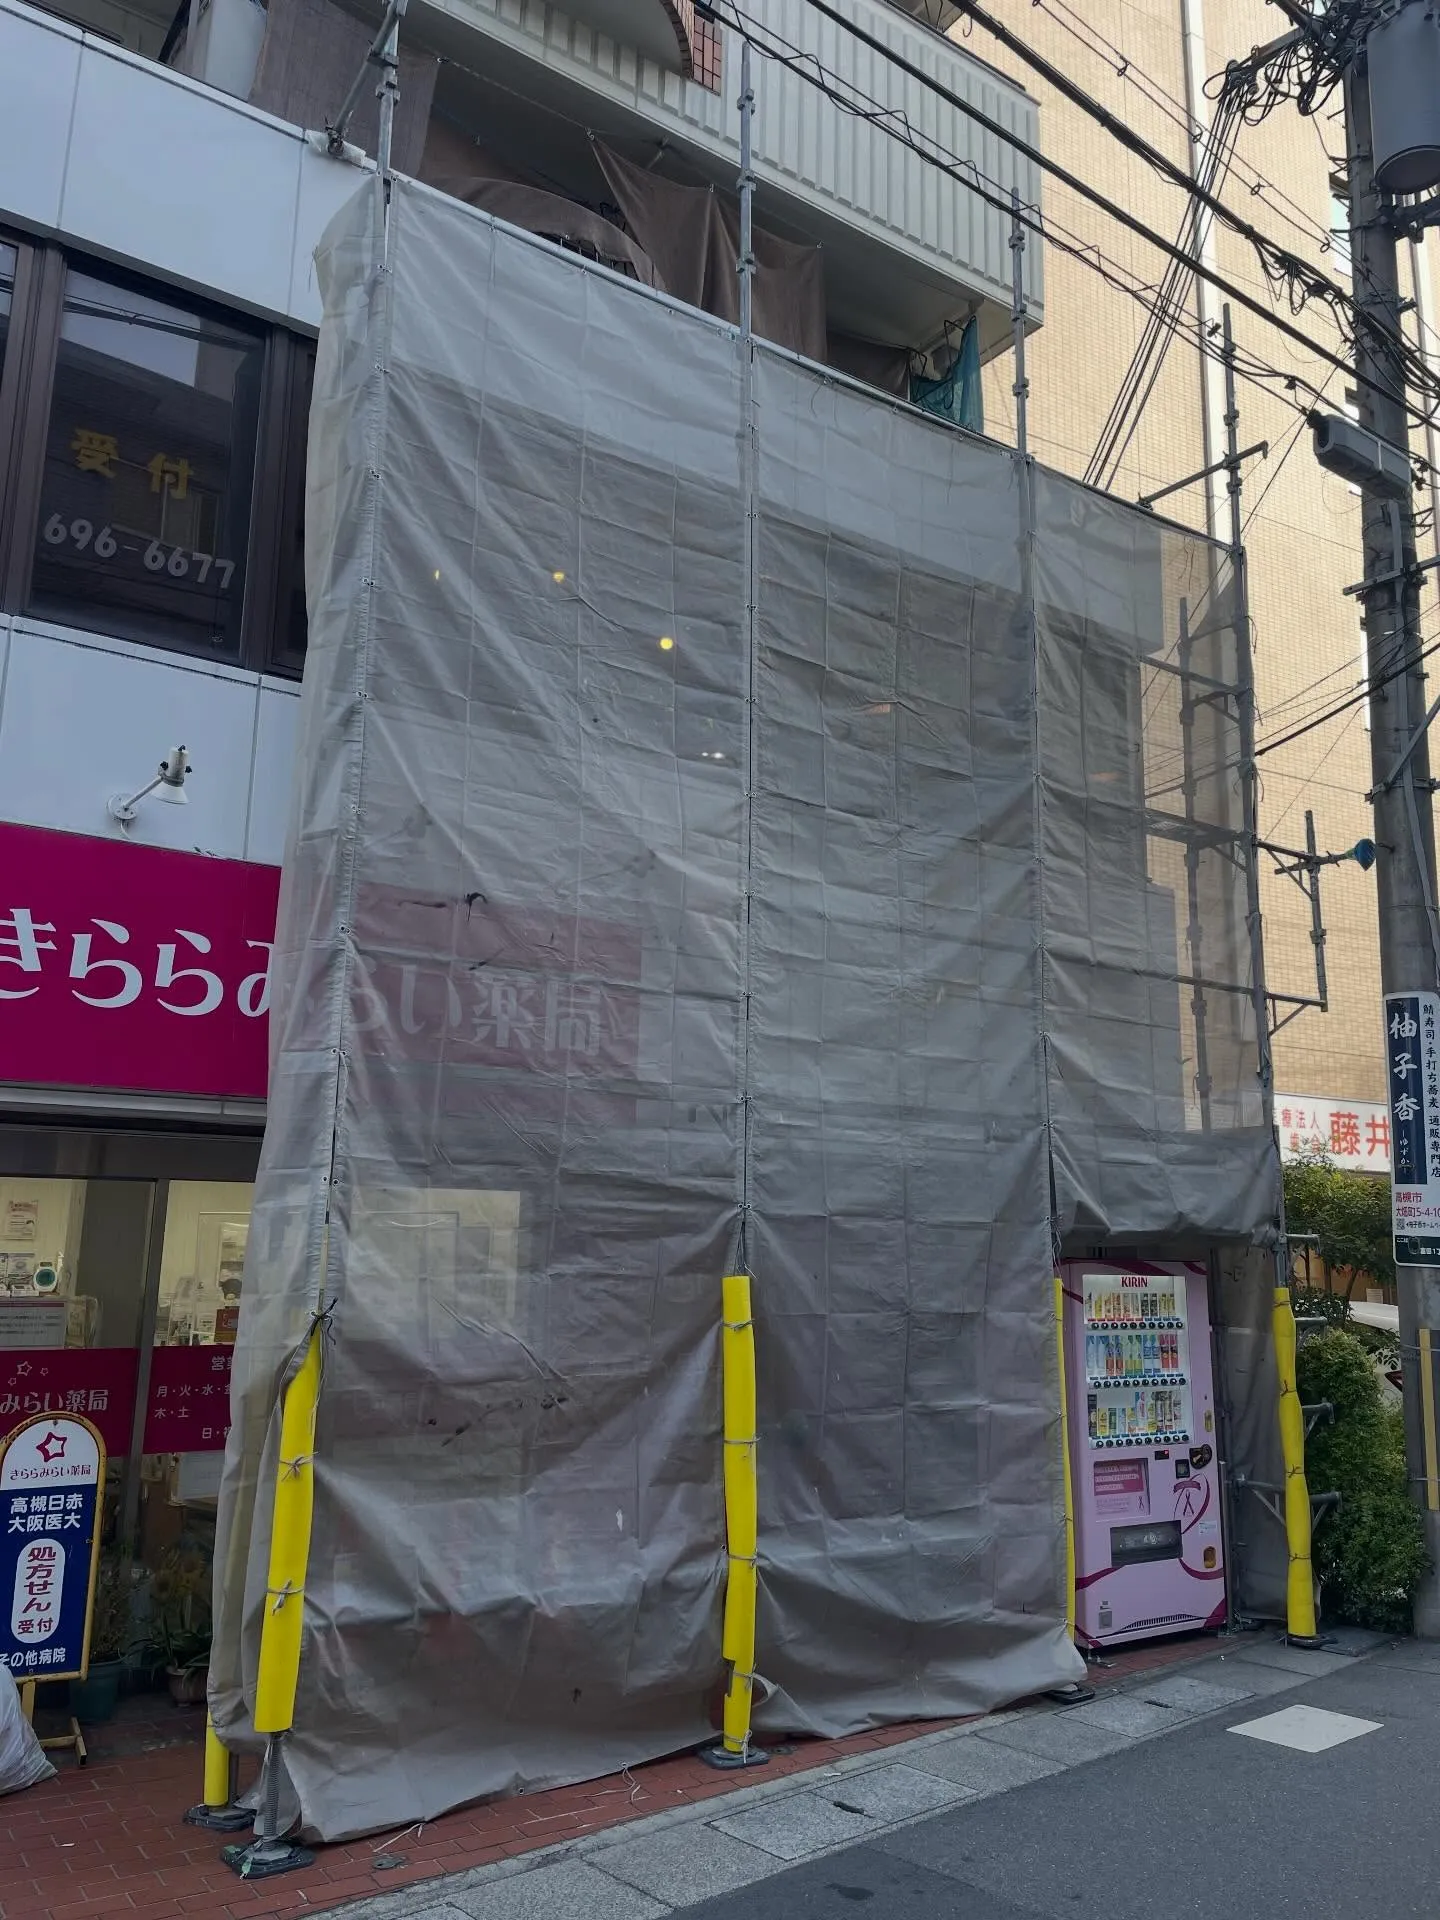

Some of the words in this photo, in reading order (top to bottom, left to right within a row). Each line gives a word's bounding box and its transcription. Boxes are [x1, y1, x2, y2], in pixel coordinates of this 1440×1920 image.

[70, 428, 196, 500] 受付
[43, 513, 236, 589] 696-6677
[1389, 1012, 1420, 1122] 柚子香
[1329, 1111, 1390, 1158] 藤井
[1121, 1276, 1148, 1288] KIRIN
[0, 1389, 108, 1415] みらい薬局
[10, 1464, 91, 1481] きららみらい薬局
[10, 1493, 83, 1514] 高槻日赤
[8, 1512, 81, 1534] 大阪医大
[22, 1546, 56, 1614] 処方せん
[17, 1617, 54, 1635] 受付
